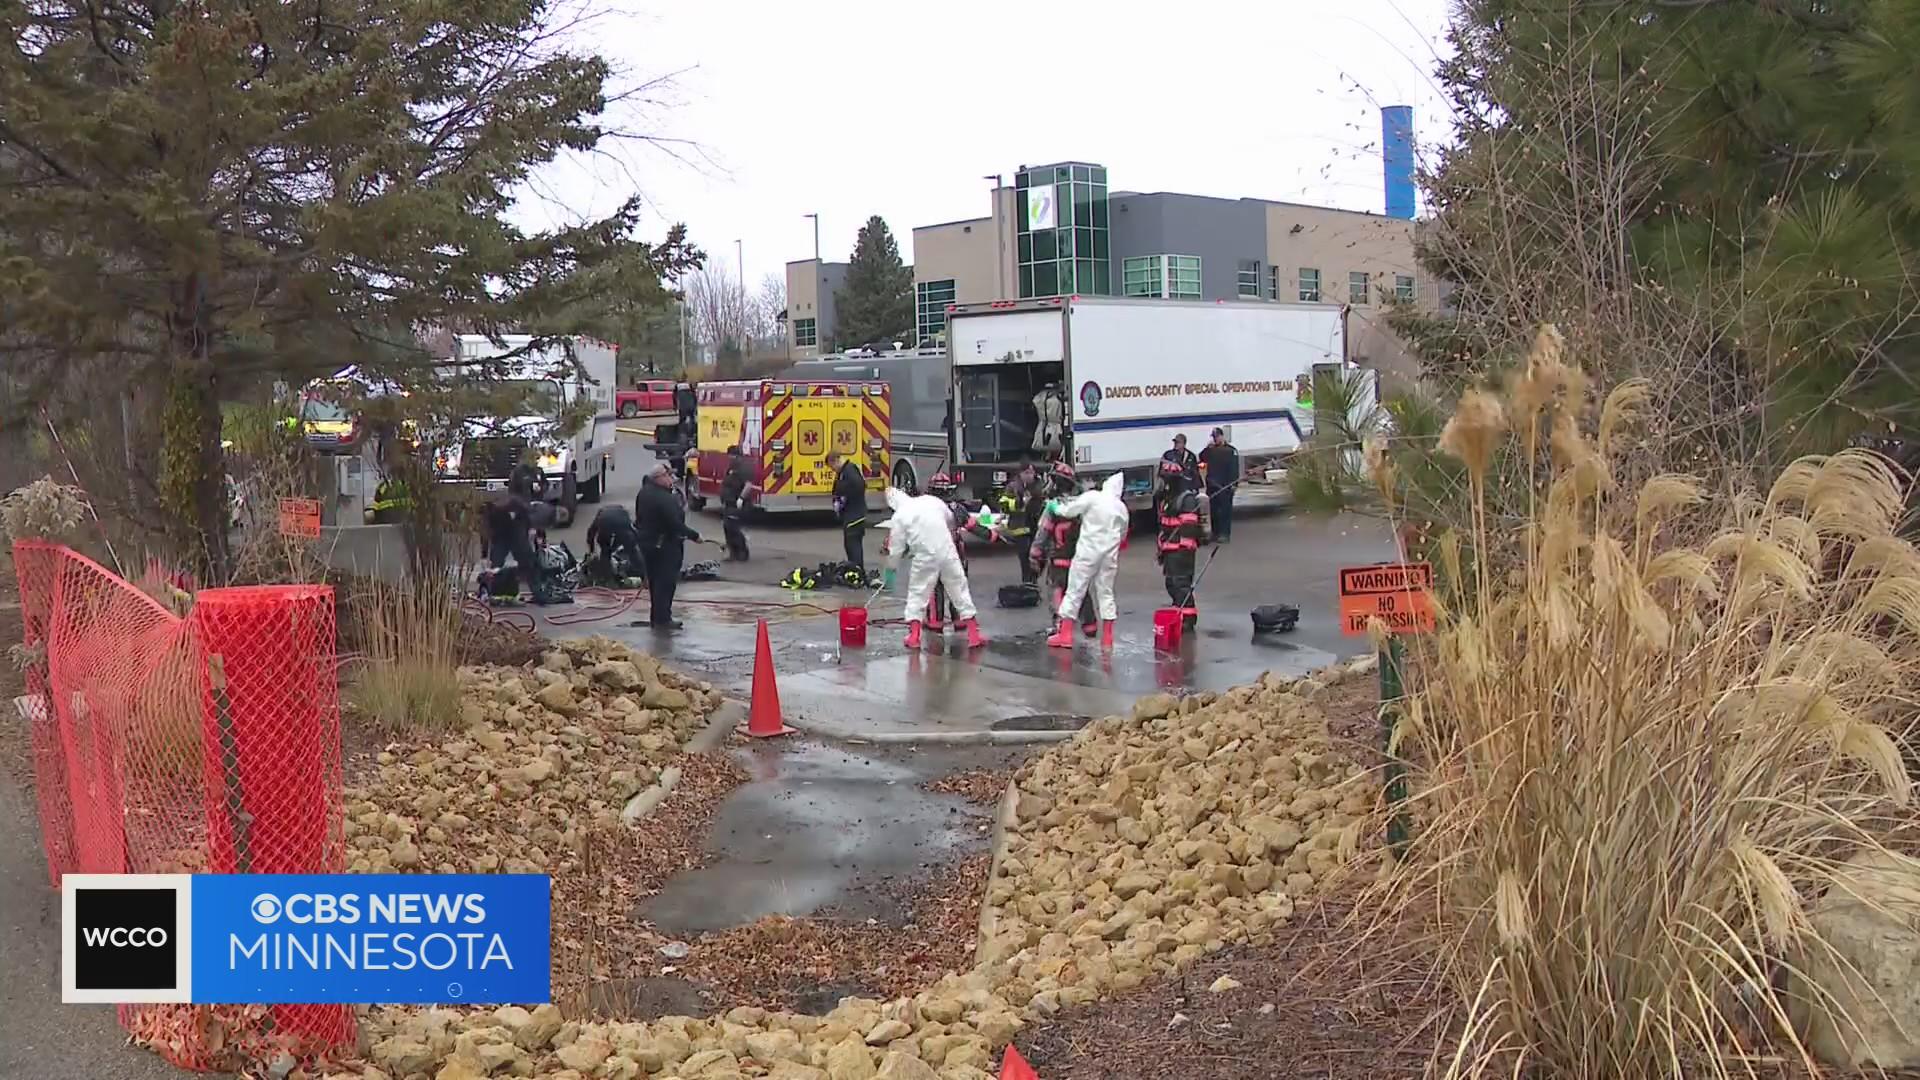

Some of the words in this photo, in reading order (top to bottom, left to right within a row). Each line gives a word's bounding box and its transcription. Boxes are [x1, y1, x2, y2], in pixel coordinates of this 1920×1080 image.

[1105, 385, 1142, 399] DAKOTA
[1145, 383, 1182, 397] COUNTY
[1185, 382, 1220, 395] SPECIAL
[1222, 381, 1270, 393] OPERATIONS
[1273, 380, 1293, 391] TEAM
[796, 471, 818, 486] M
[1351, 571, 1420, 589] WARNING
[1378, 596, 1395, 612] NO
